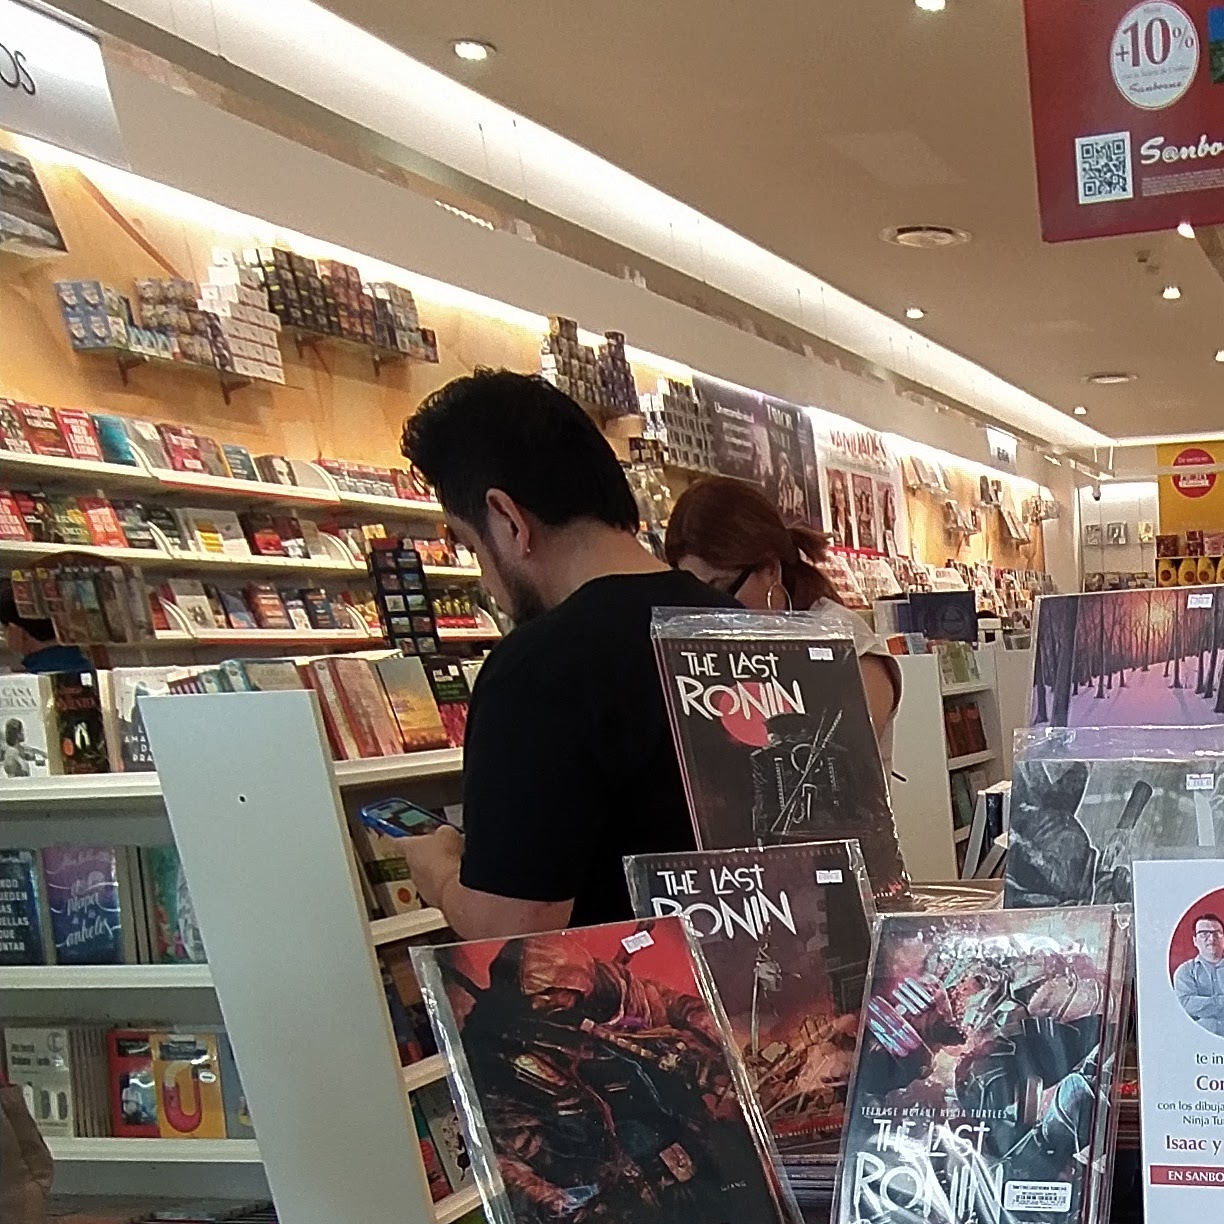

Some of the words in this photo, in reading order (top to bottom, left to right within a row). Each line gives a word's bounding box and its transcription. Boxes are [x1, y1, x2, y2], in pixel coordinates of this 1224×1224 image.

[680, 651, 722, 677] THE
[728, 650, 780, 680] LAST
[674, 674, 807, 721] RONIN
[656, 870, 701, 896] THE
[709, 863, 766, 896] LAST
[651, 889, 798, 942] RONIN
[1195, 1052, 1208, 1066] te
[970, 1108, 1008, 1120] TURTLES
[1157, 1101, 1177, 1111] con
[1178, 1101, 1193, 1111] los
[1182, 1115, 1210, 1127] Ninja
[872, 1118, 918, 1153] THE
[926, 1120, 992, 1159] LAST
[1165, 1134, 1208, 1151] Isaac
[1212, 1138, 1222, 1155] y
[1168, 1170, 1183, 1181] EN
